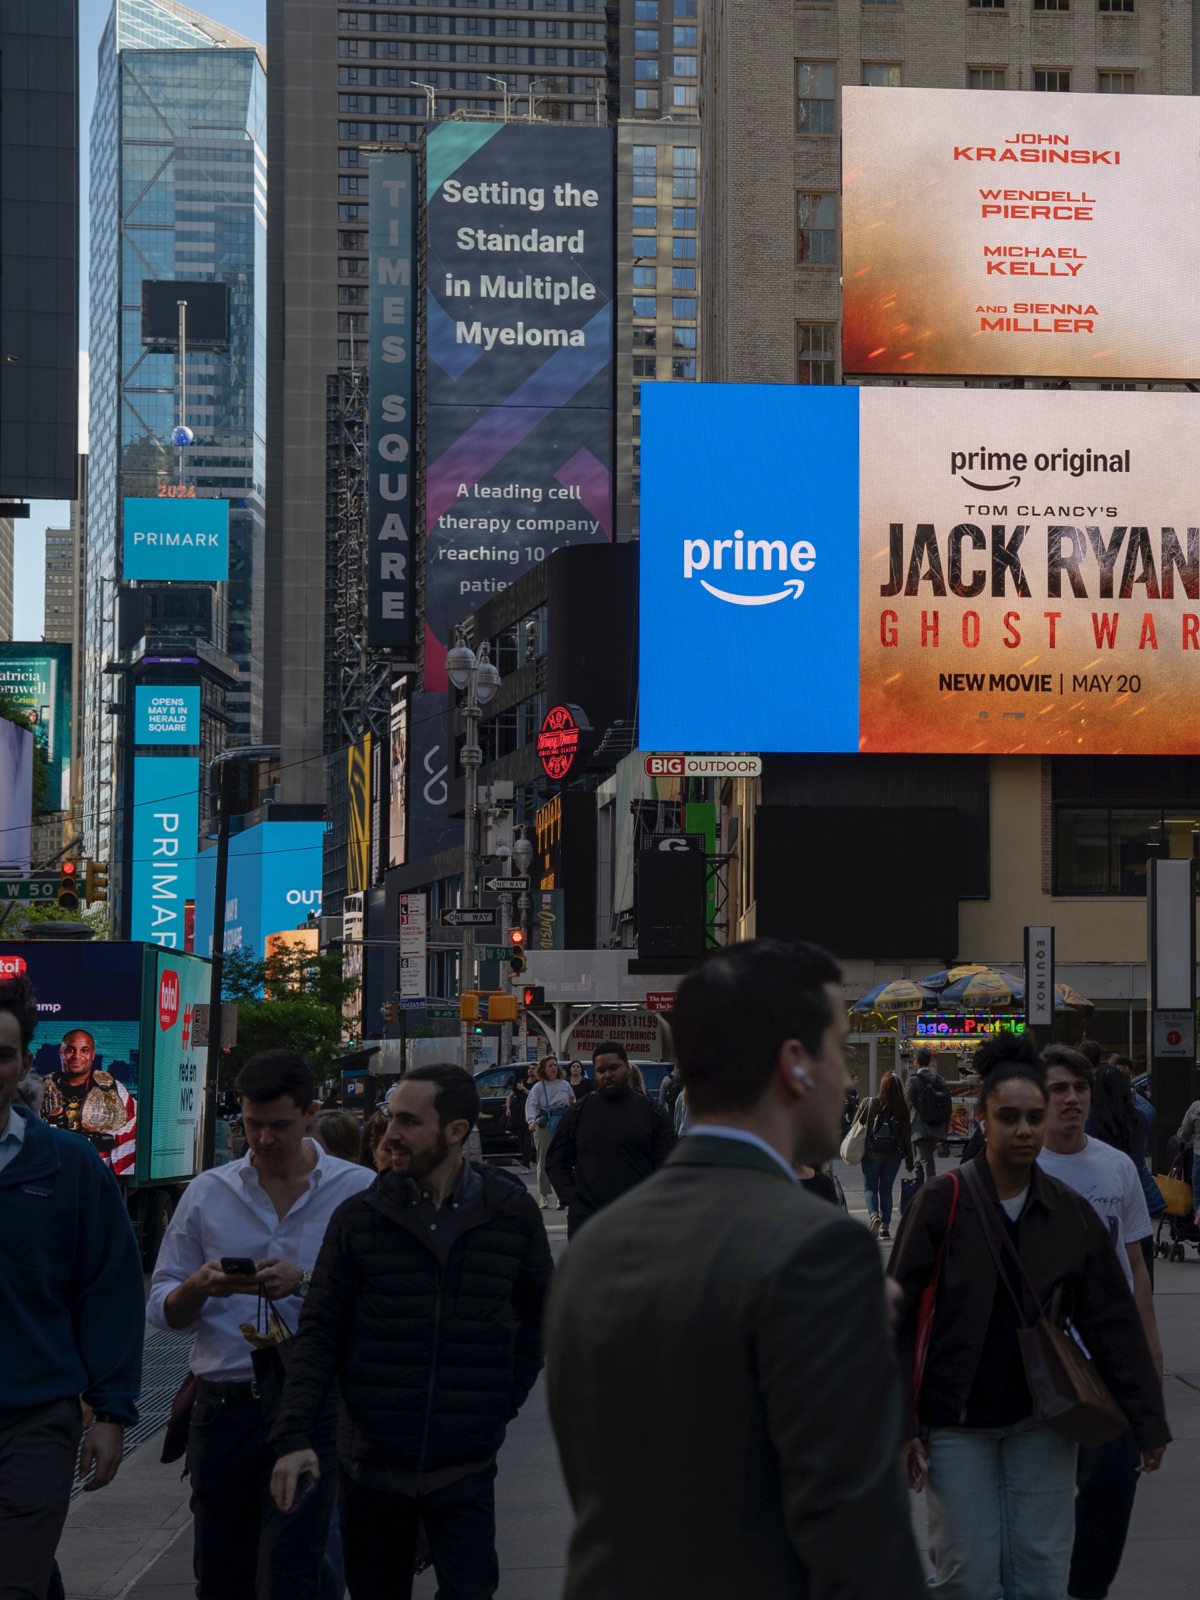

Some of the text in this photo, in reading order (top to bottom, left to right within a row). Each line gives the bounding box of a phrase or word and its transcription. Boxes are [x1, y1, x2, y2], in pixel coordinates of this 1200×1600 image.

[1004, 133, 1069, 145] JOHN
[953, 147, 1120, 165] KRASINSKI
[442, 179, 599, 212] Setting the
[979, 189, 1096, 202] WENDELL
[981, 204, 1093, 221] PIERCE
[456, 226, 584, 254] Standard
[983, 246, 1087, 259] MICHAEL
[378, 180, 410, 364] TIMES
[986, 261, 1084, 276] KELLY
[445, 272, 596, 306] in Multiple
[975, 303, 1099, 315] AND SIENNA
[980, 317, 1094, 334] MILLER
[456, 321, 586, 351] Myeloma
[951, 446, 1131, 478] prime original
[456, 483, 582, 503] A leading cell
[378, 394, 410, 620] SQUARE
[964, 504, 1119, 518] TOM CLANCY'S
[438, 514, 600, 535] therapy company
[133, 532, 220, 547] PRIMARK
[438, 546, 520, 565] reaching
[524, 546, 546, 562] 10
[683, 529, 817, 578] prime
[880, 522, 1200, 600] JACK RYAN
[460, 579, 515, 595] patie
[880, 609, 1200, 650] GHOST WAR
[0, 668, 40, 682] atricia
[939, 672, 1142, 693] NEW MOVIE MAY 20
[148, 706, 188, 714] MAY 8 IN
[152, 698, 184, 706] OPENS
[148, 724, 187, 732] SQUARE
[651, 758, 757, 774] BIG OUTDOOR
[151, 813, 180, 949] PRIMAR
[6, 883, 54, 897] W 50
[486, 950, 494, 960] W
[496, 950, 506, 960] 50
[1035, 940, 1046, 1011] EQUINOX
[161, 978, 178, 1012] total
[442, 1008, 452, 1016] 49
[454, 1008, 460, 1016] S
[877, 1000, 921, 1010] SABRETT
[633, 1015, 658, 1028] $11.99
[572, 1029, 604, 1039] LUGGAGE
[610, 1030, 657, 1041] ELECTRONICS
[626, 1043, 651, 1053] CARDS
[180, 1088, 194, 1112] NYC
